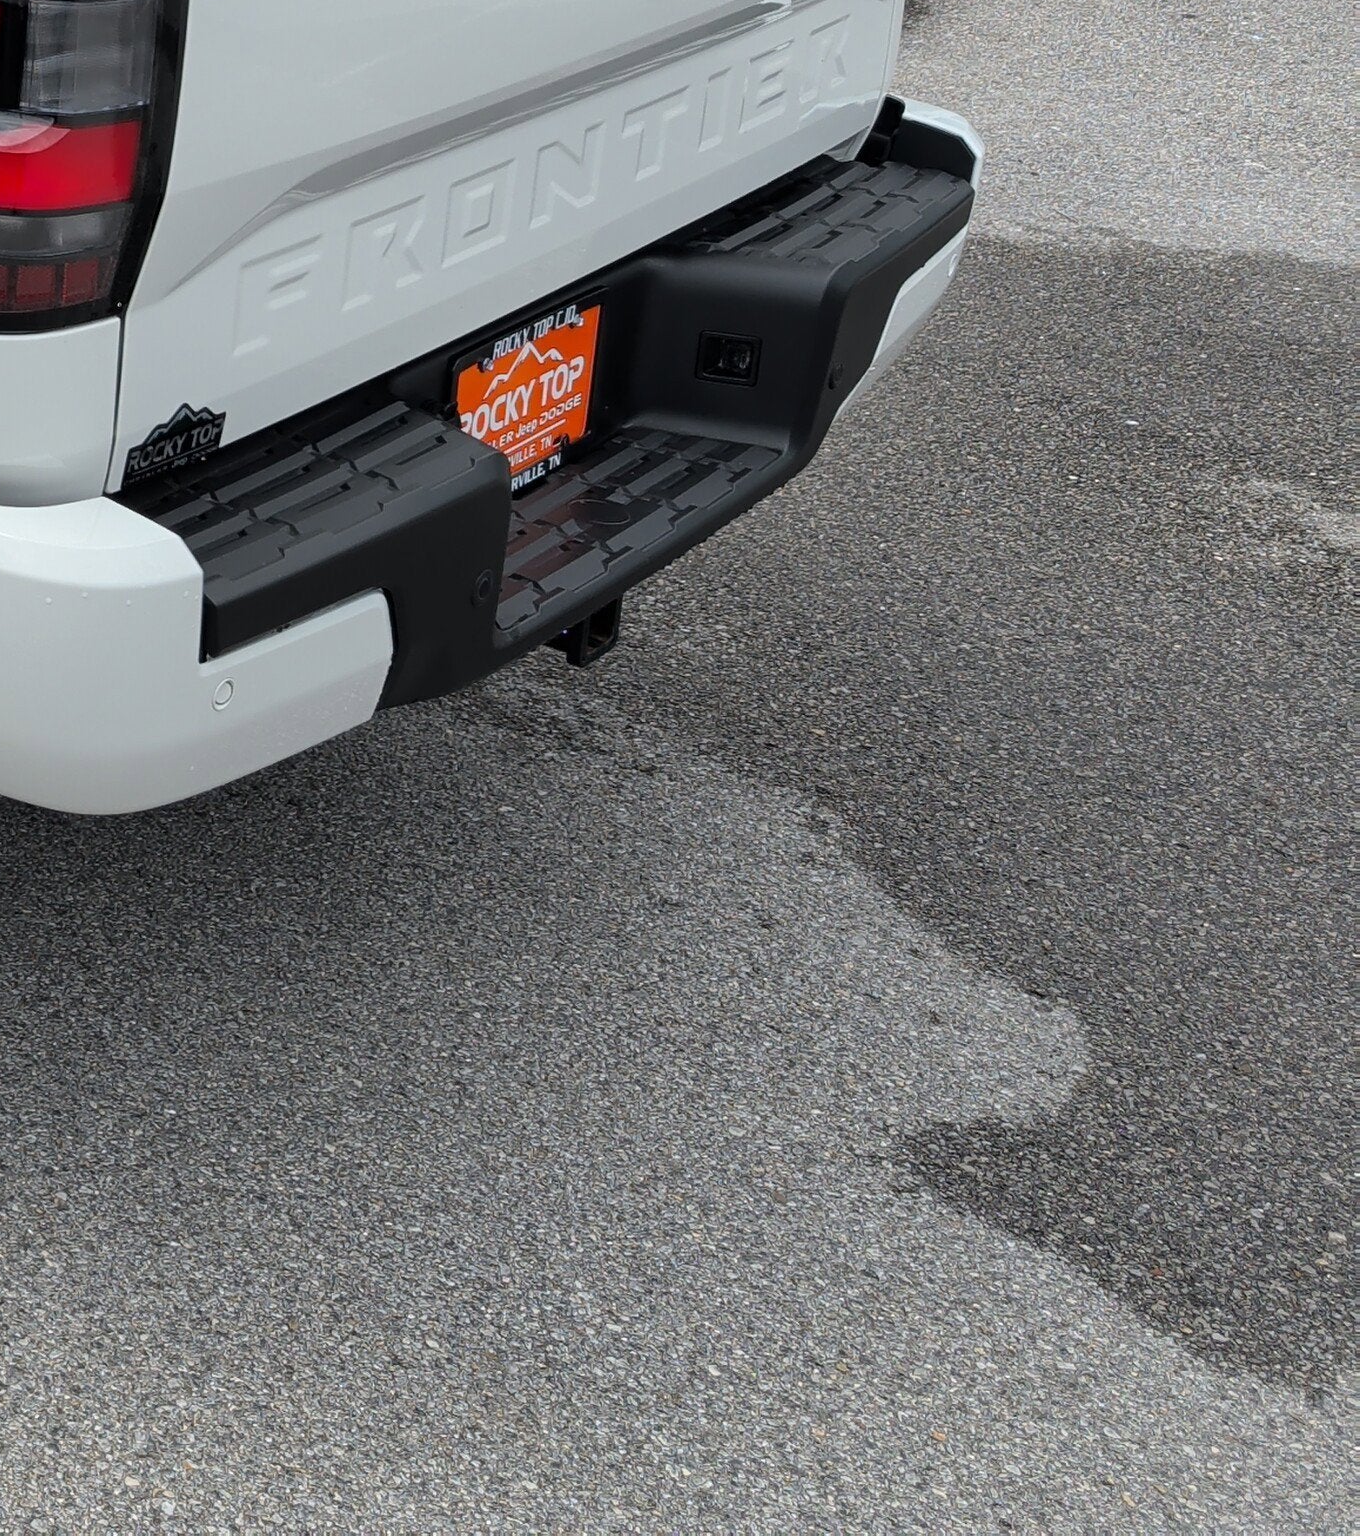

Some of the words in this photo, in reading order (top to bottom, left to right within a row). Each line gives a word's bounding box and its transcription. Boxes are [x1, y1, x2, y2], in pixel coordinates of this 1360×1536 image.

[233, 13, 851, 357] FRONTIER
[493, 326, 531, 360] ROCKY
[533, 315, 555, 341] TOP
[539, 356, 585, 407] TOP
[516, 418, 538, 439] Jeep
[539, 393, 583, 425] DODGE
[127, 431, 189, 473] ROCKY
[541, 434, 554, 452] TN
[548, 452, 562, 467] TN
